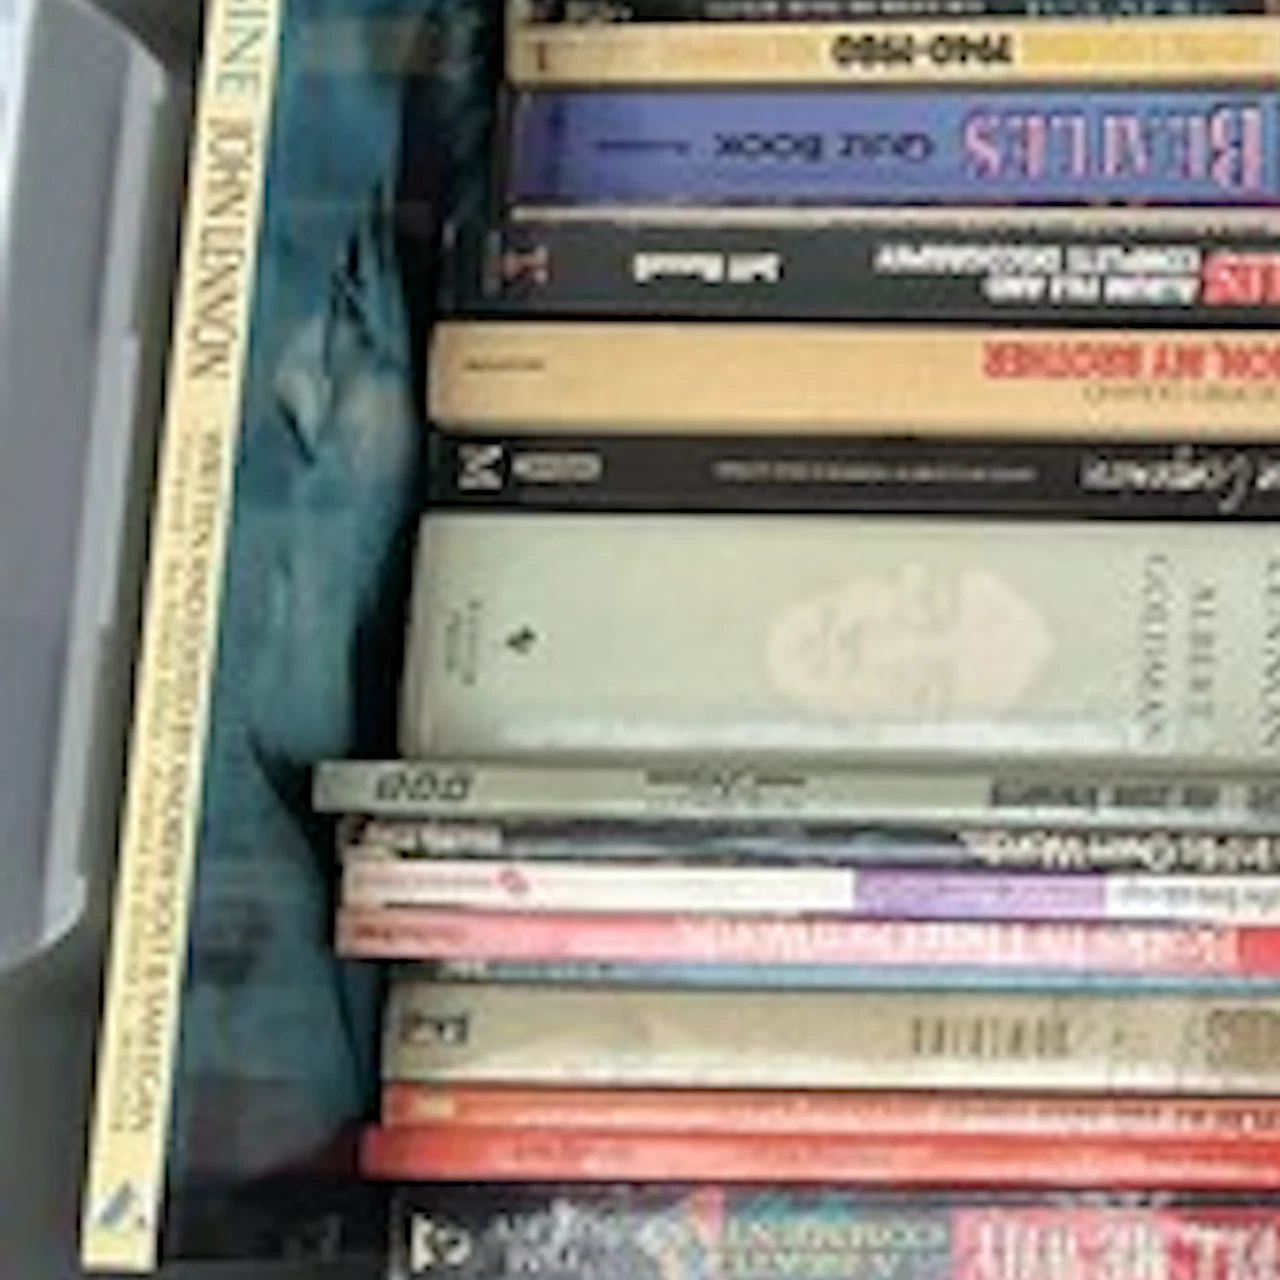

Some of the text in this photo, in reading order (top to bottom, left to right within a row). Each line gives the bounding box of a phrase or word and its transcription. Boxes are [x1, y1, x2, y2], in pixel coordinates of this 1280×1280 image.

[831, 31, 1014, 67] 1940-1980
[206, 118, 255, 223] JOHN
[715, 105, 1266, 199] BEATLES QUIZ BOOK
[731, 250, 781, 283] Jeff
[189, 226, 248, 381] LENNON
[983, 342, 1143, 380] BROTHER
[1151, 346, 1207, 380] MY
